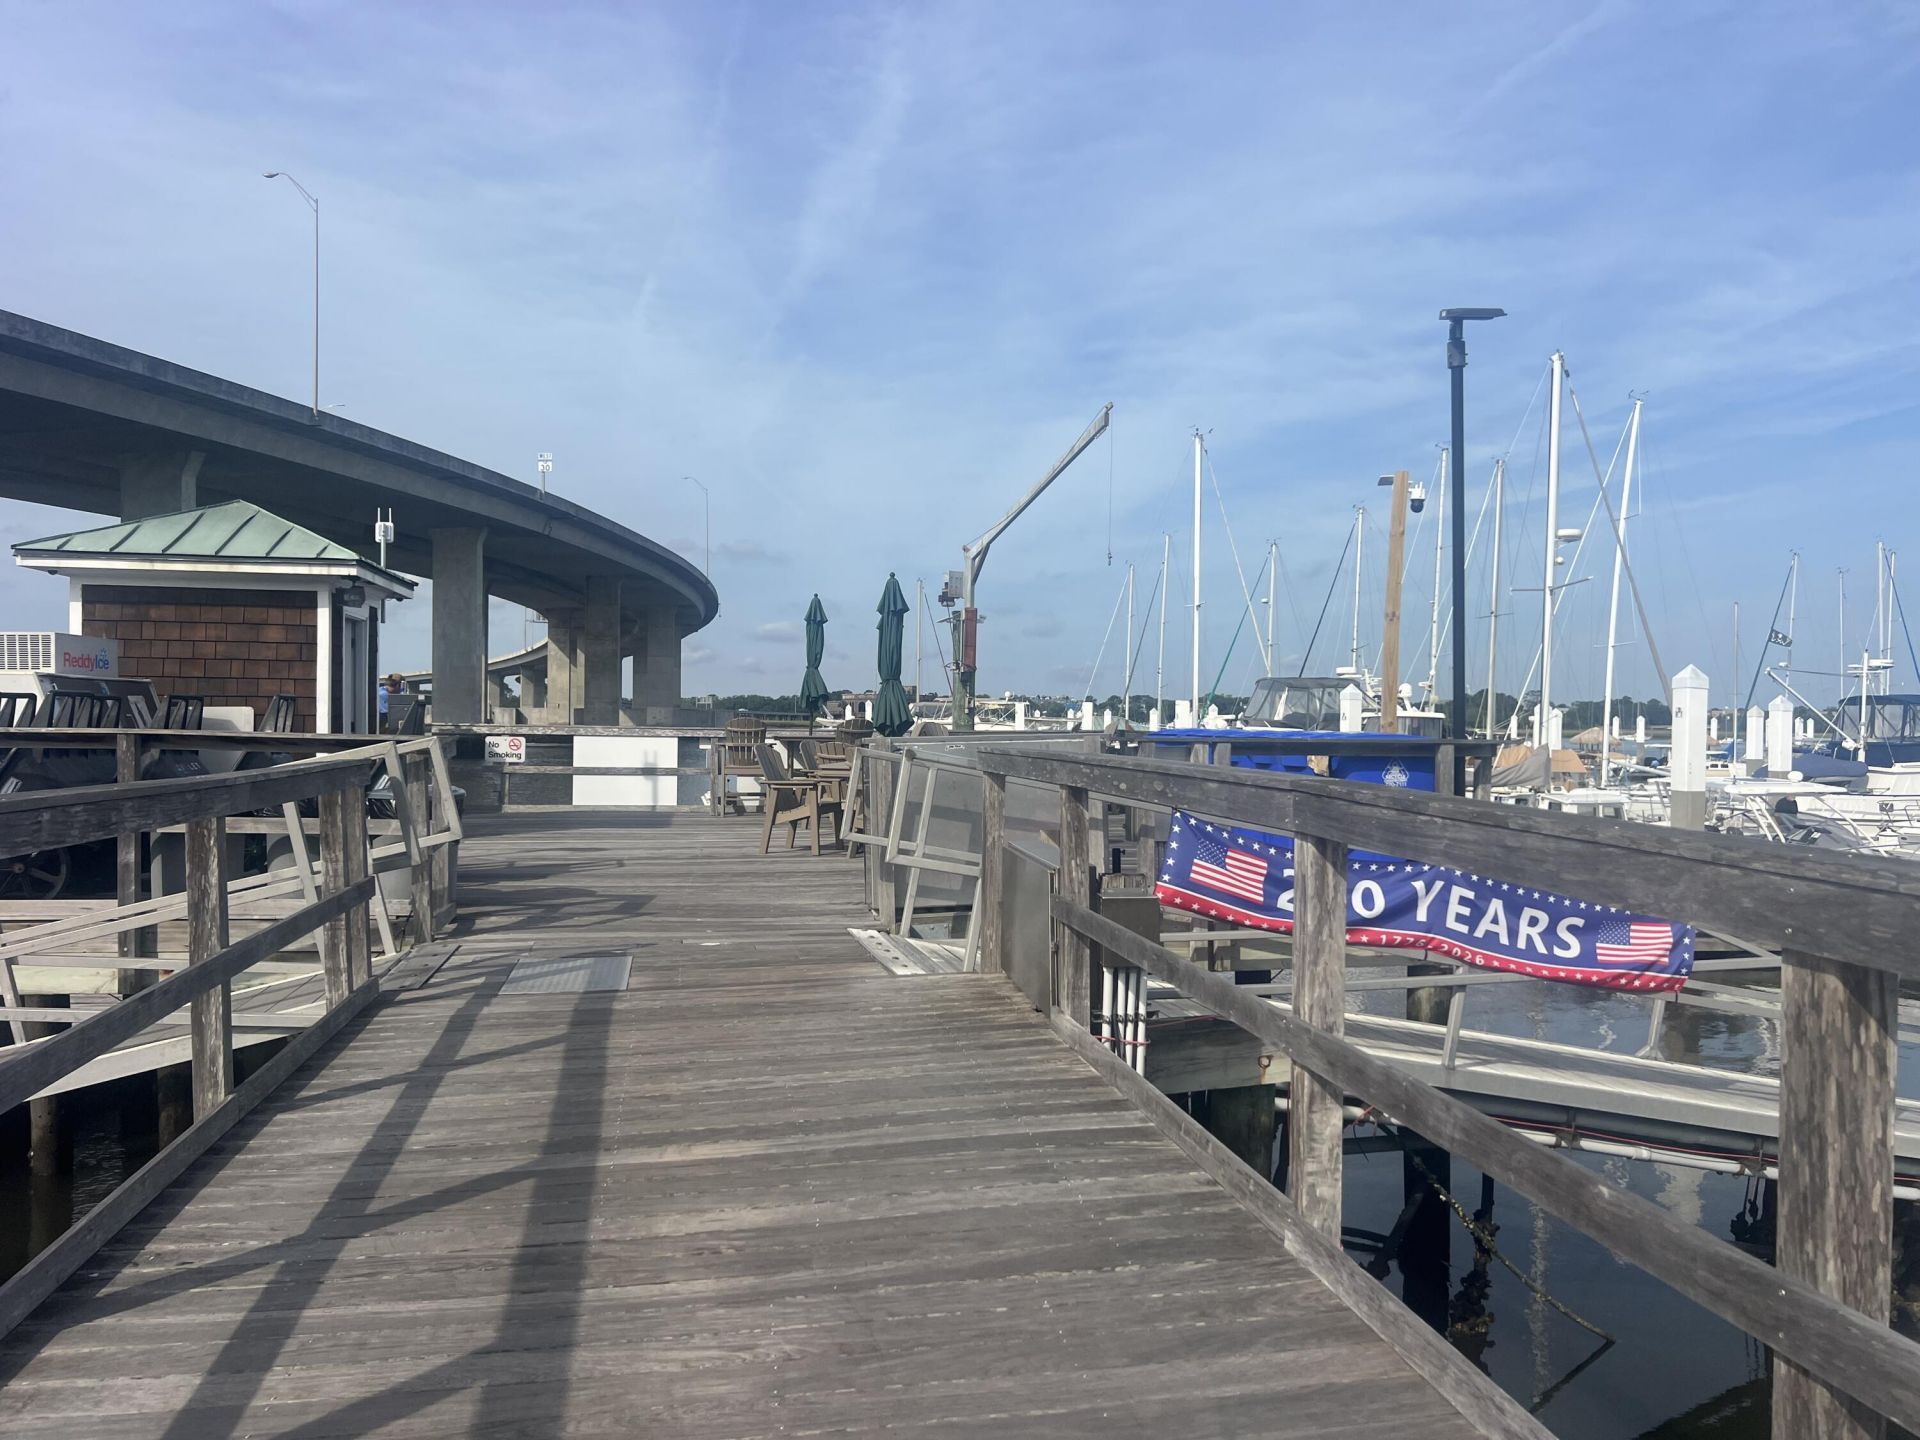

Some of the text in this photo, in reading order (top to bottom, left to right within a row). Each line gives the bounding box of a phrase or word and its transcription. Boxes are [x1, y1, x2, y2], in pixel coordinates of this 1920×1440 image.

[488, 751, 521, 760] Smoking
[1277, 868, 1585, 958] 20 YEARS
